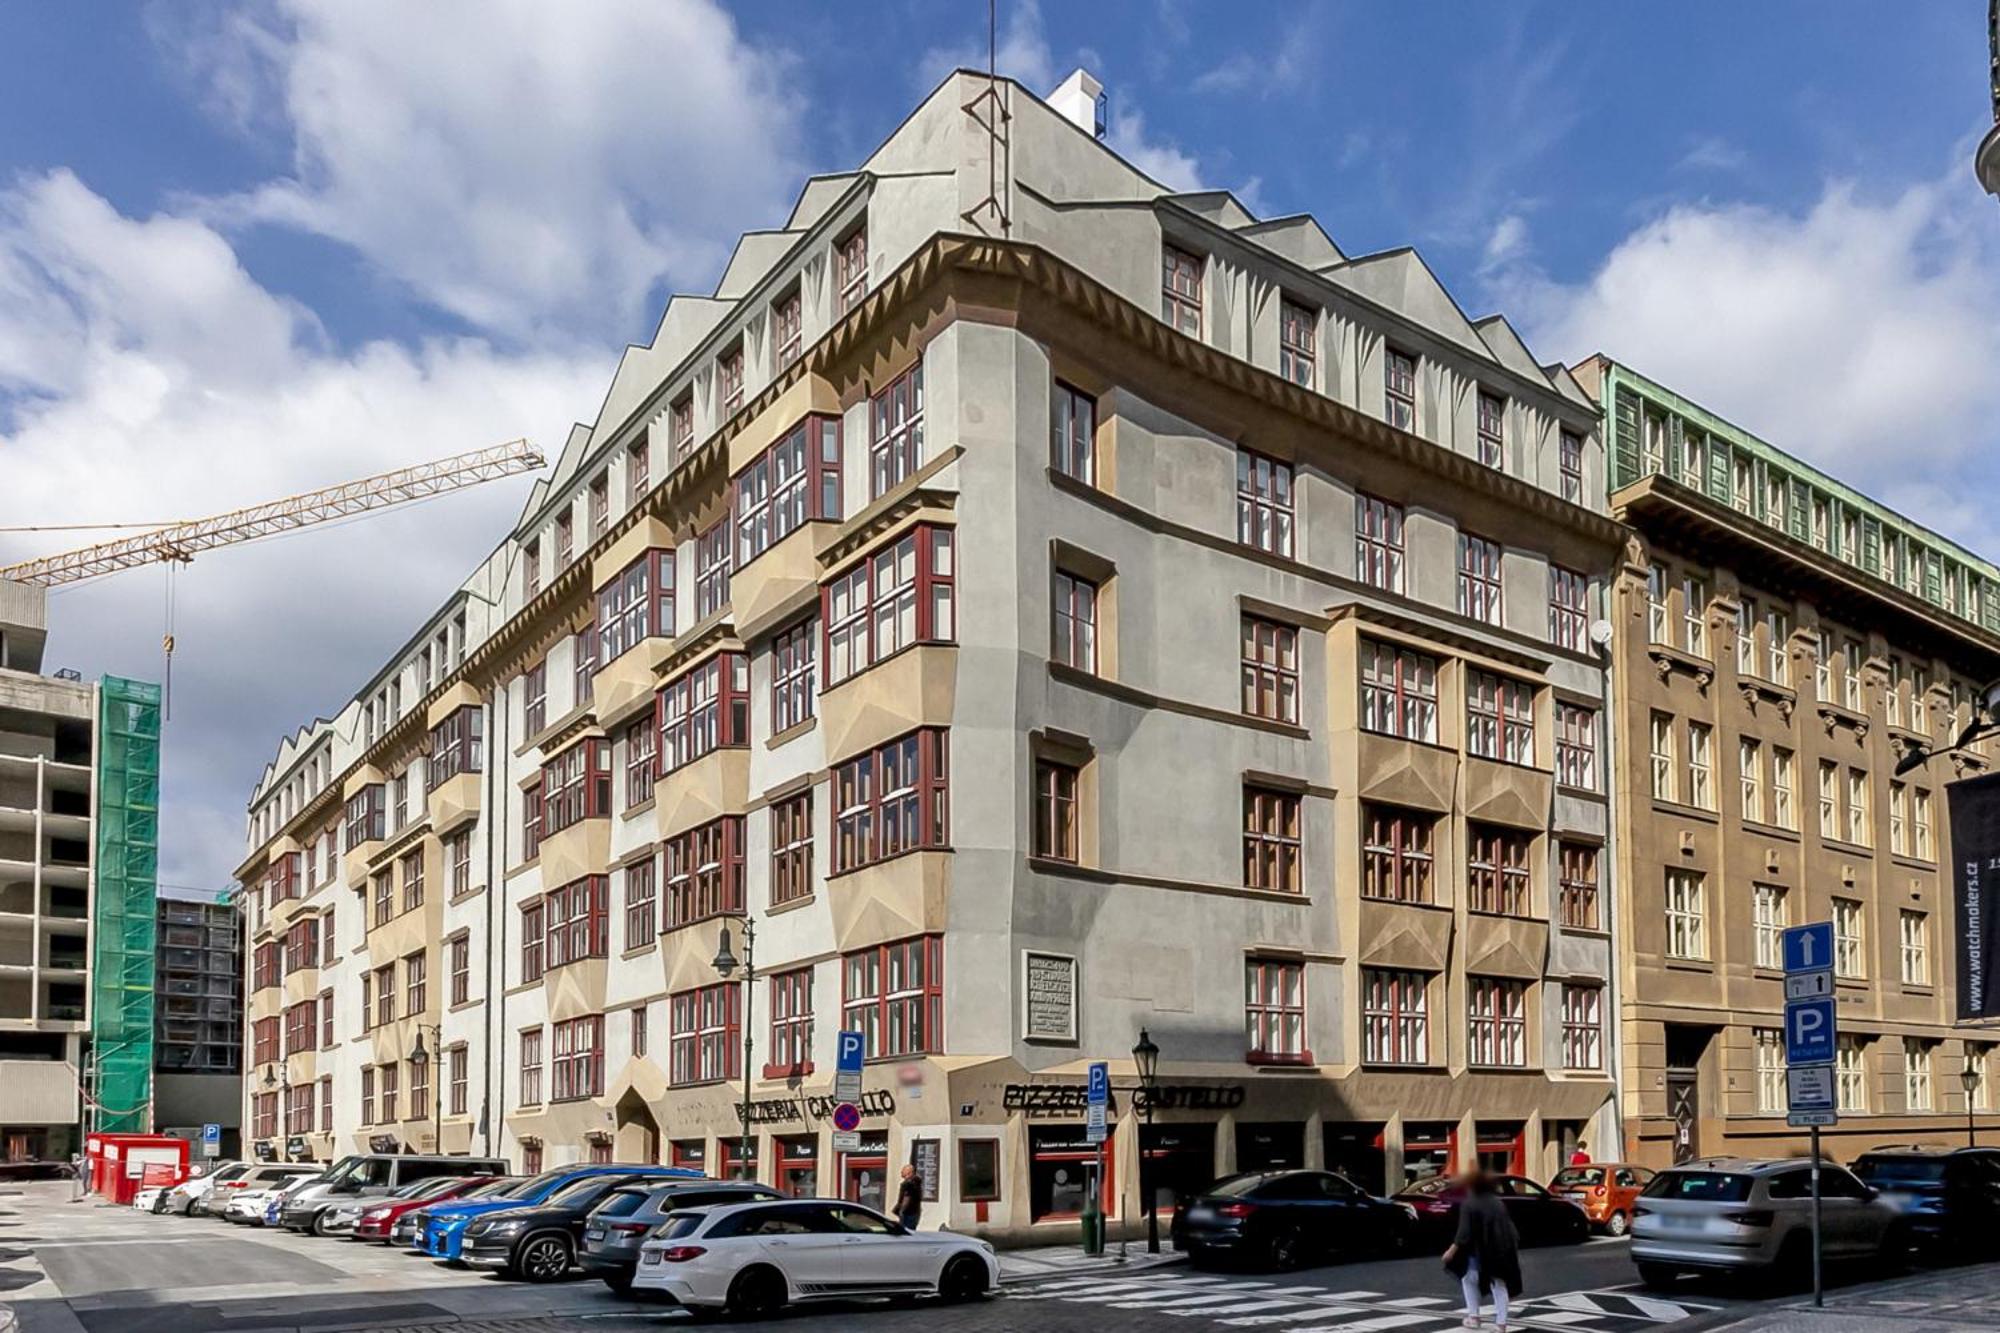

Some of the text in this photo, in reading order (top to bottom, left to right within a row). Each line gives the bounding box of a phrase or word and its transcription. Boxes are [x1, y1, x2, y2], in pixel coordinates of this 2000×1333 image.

[1965, 861, 1982, 1012] www.watchmakers.cz
[1795, 1008, 1824, 1045] P
[843, 1037, 859, 1060] P
[1092, 1067, 1104, 1091] P
[206, 1126, 217, 1140] P
